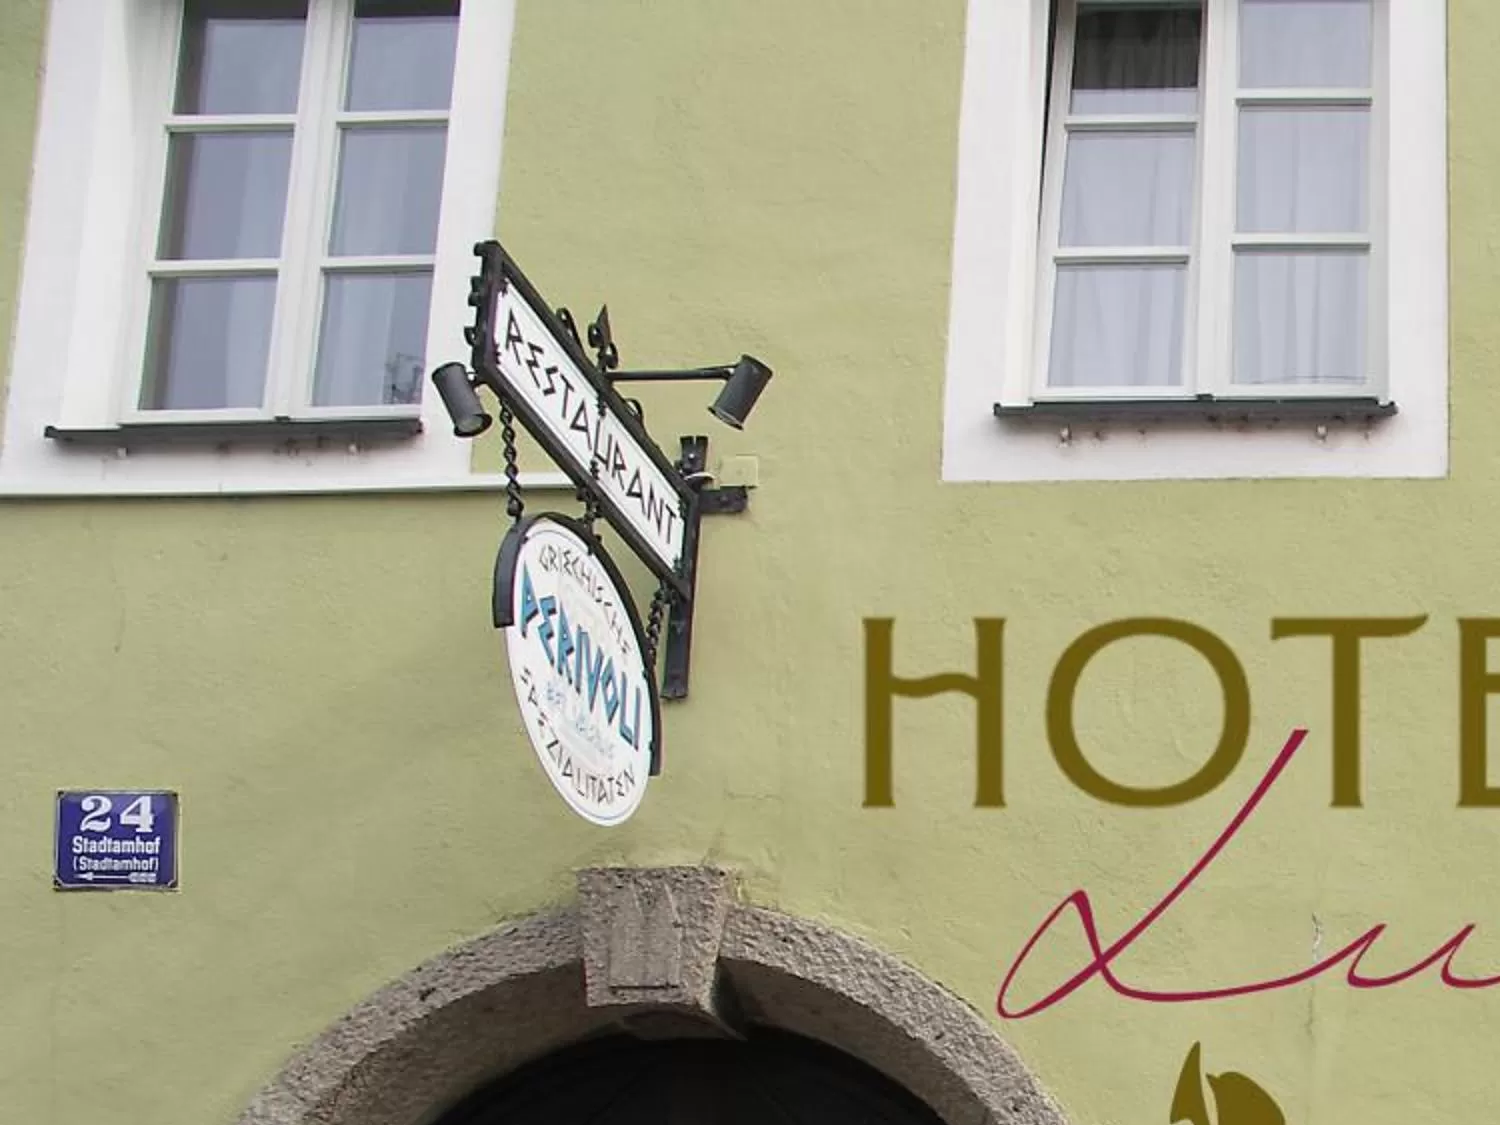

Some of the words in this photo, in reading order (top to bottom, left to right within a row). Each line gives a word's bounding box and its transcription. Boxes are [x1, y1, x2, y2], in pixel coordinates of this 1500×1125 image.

[504, 308, 677, 544] RESTAURANT
[519, 560, 642, 752] PERIVOLI
[72, 836, 161, 854] Stadtamhof
[80, 795, 155, 832] 24
